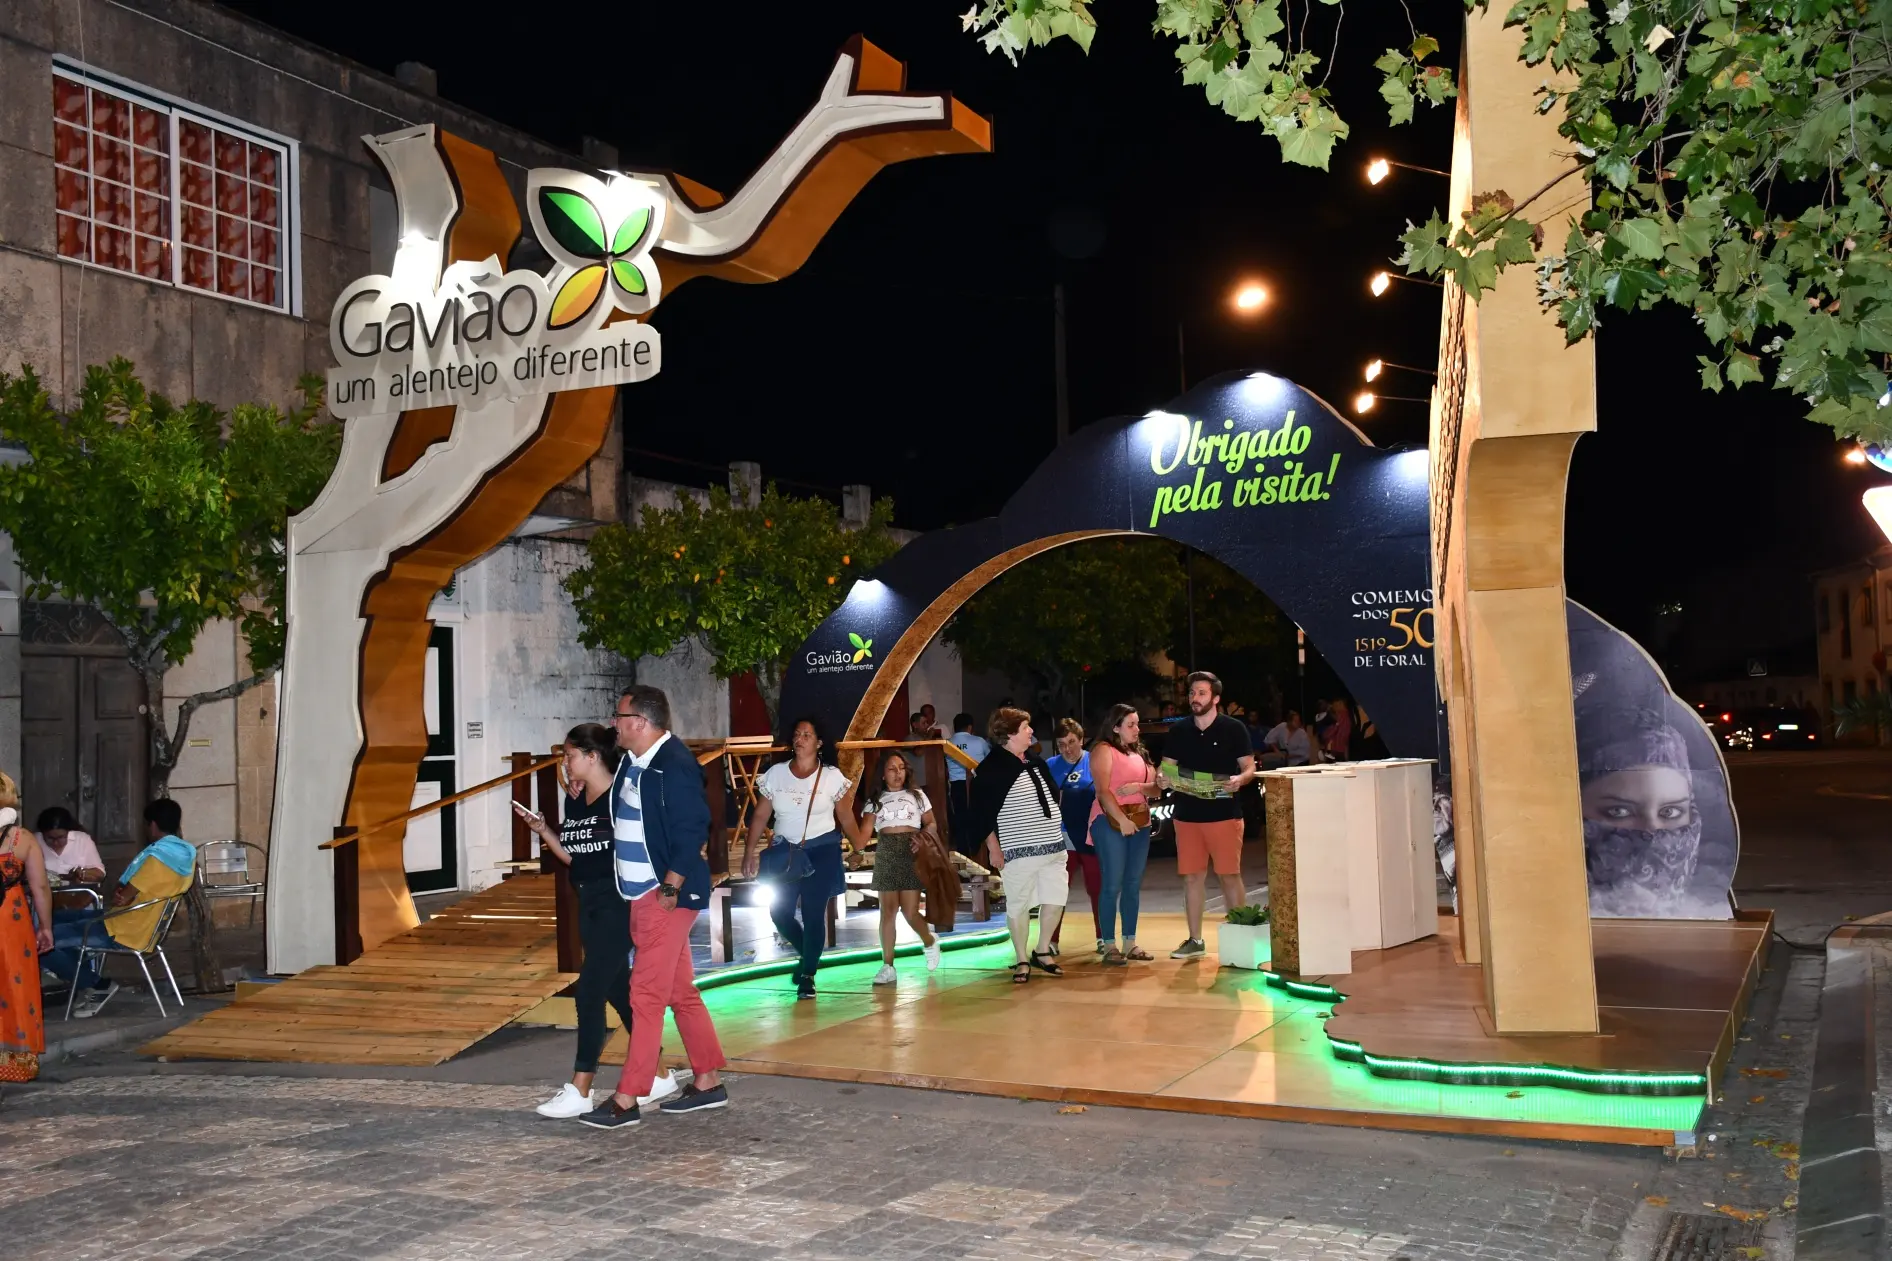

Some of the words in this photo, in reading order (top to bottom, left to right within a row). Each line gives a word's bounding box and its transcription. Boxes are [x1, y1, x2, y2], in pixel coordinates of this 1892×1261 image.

[339, 271, 538, 358] Gavião
[336, 377, 375, 404] um
[389, 354, 498, 397] alentejo
[514, 338, 650, 381] diferente
[1150, 411, 1312, 475] Obrigado
[1149, 467, 1223, 528] pela
[1233, 453, 1341, 508] visita!
[1355, 638, 1386, 652] 1519
[806, 650, 851, 665] Gavião
[1354, 656, 1373, 668] DE
[1380, 654, 1426, 667] FORAL
[819, 665, 843, 673] alentejo
[845, 662, 874, 671] diferente
[563, 816, 598, 828] COFFEE
[560, 828, 593, 841] OFFICE
